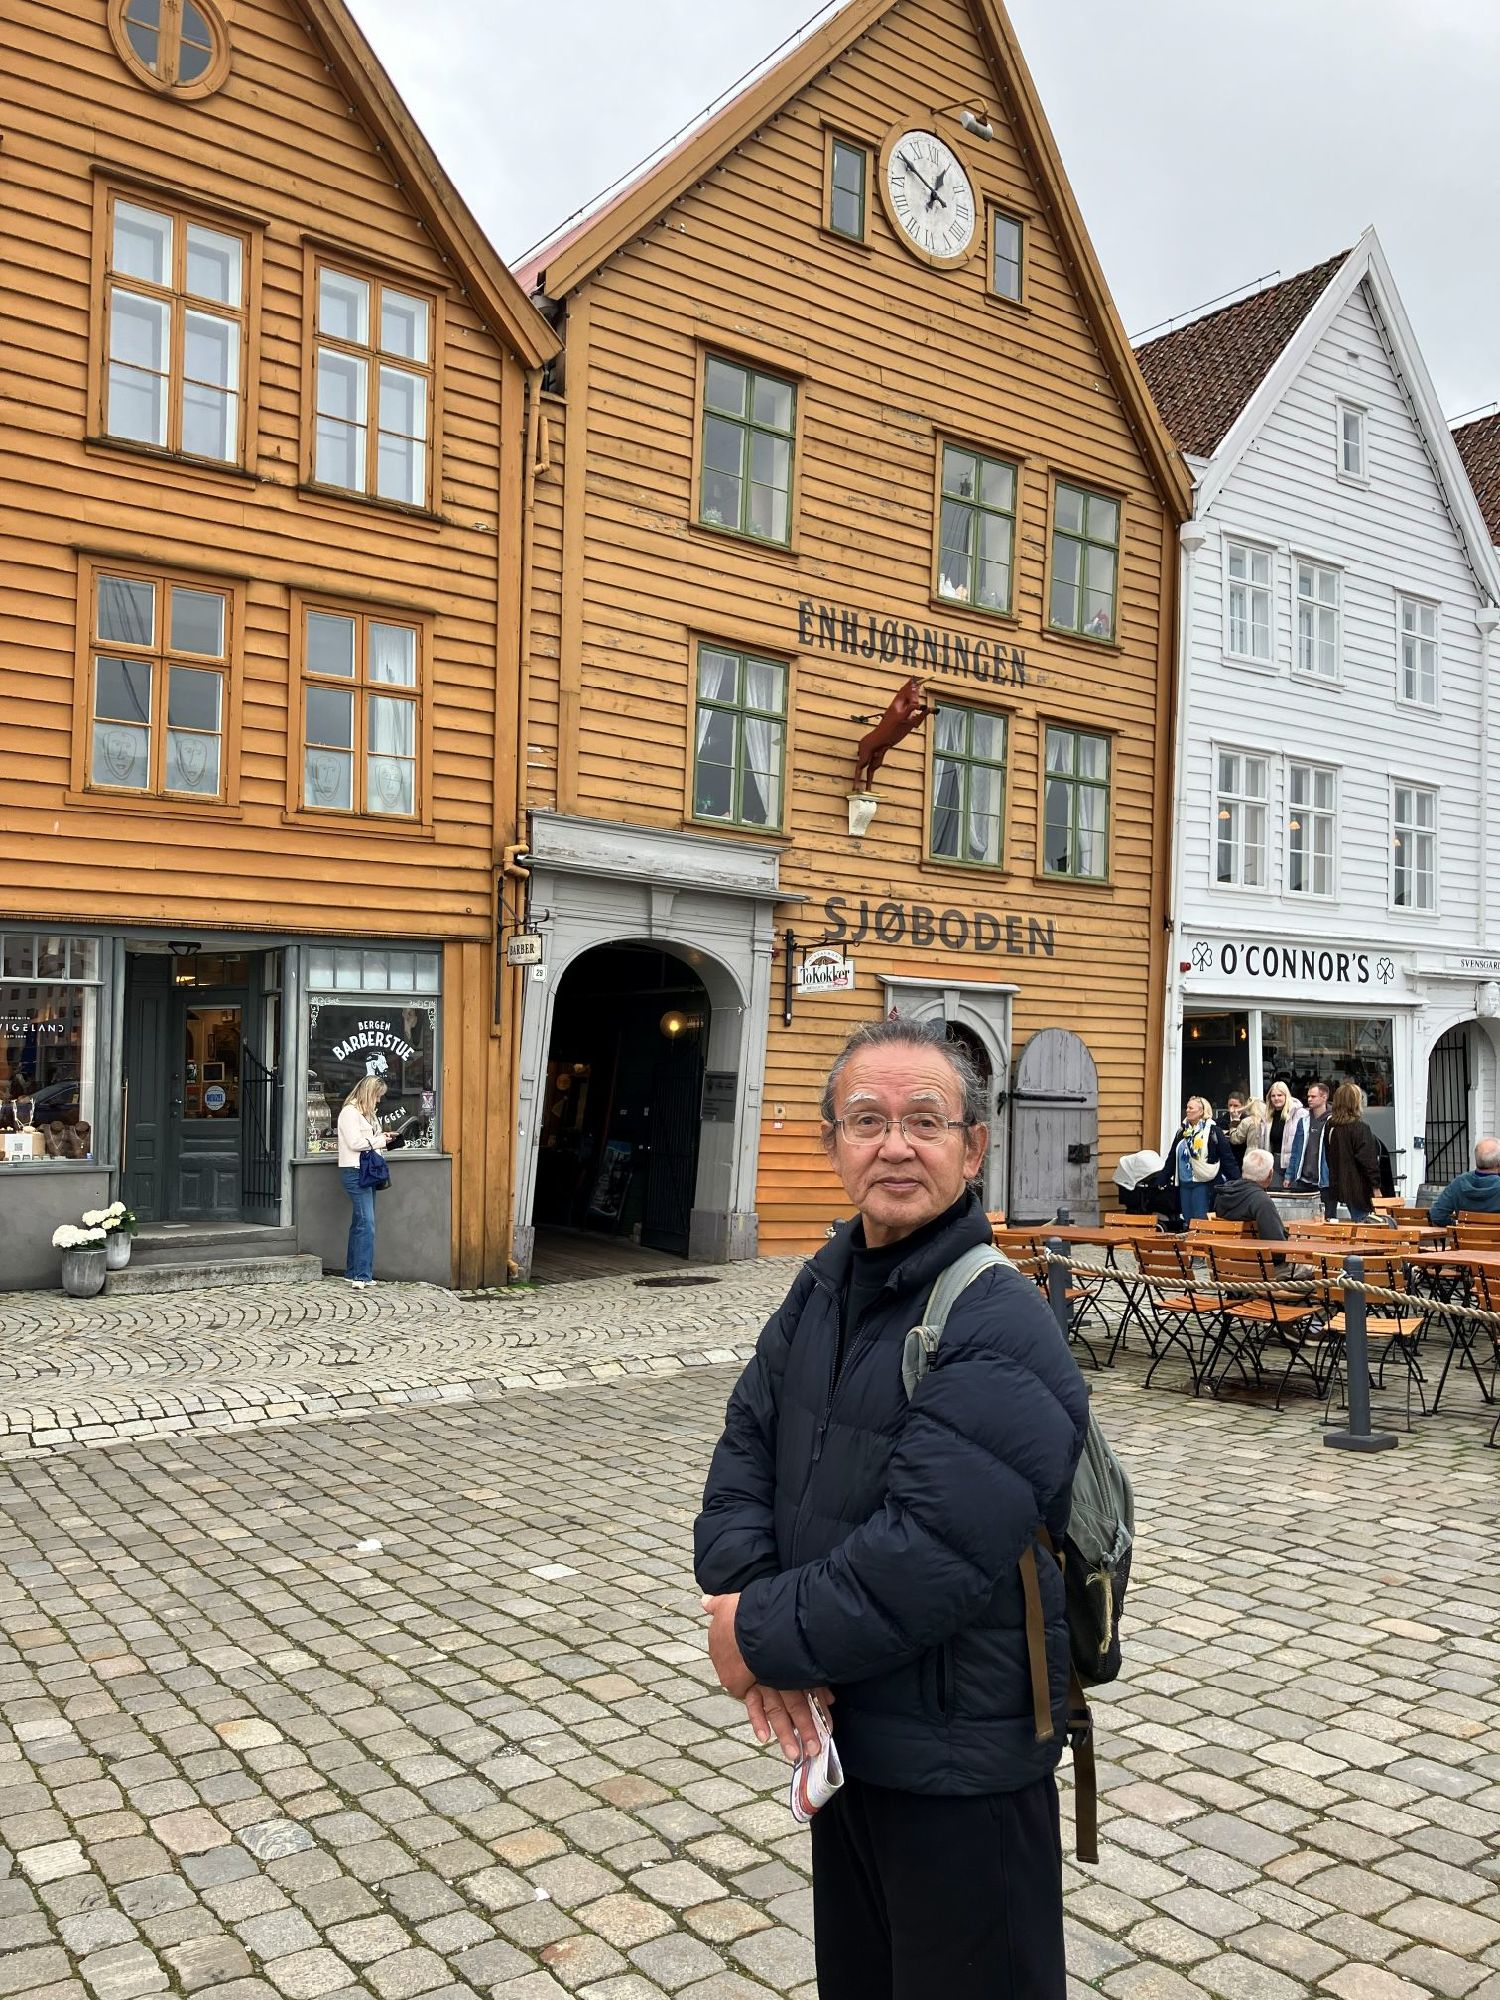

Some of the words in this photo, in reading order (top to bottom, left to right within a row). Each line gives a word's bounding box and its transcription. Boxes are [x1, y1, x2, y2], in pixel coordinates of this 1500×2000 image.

[798, 600, 1026, 689] ENHJØRNINGEN
[824, 896, 1055, 957] SJØBODEN
[510, 943, 535, 956] BARBER
[535, 969, 544, 977] 29
[1220, 943, 1370, 984] O'CONNOR'S
[358, 1020, 391, 1031] BERGEN
[332, 1031, 415, 1061] BARBERSTUE
[378, 1106, 407, 1124] YGGEN
